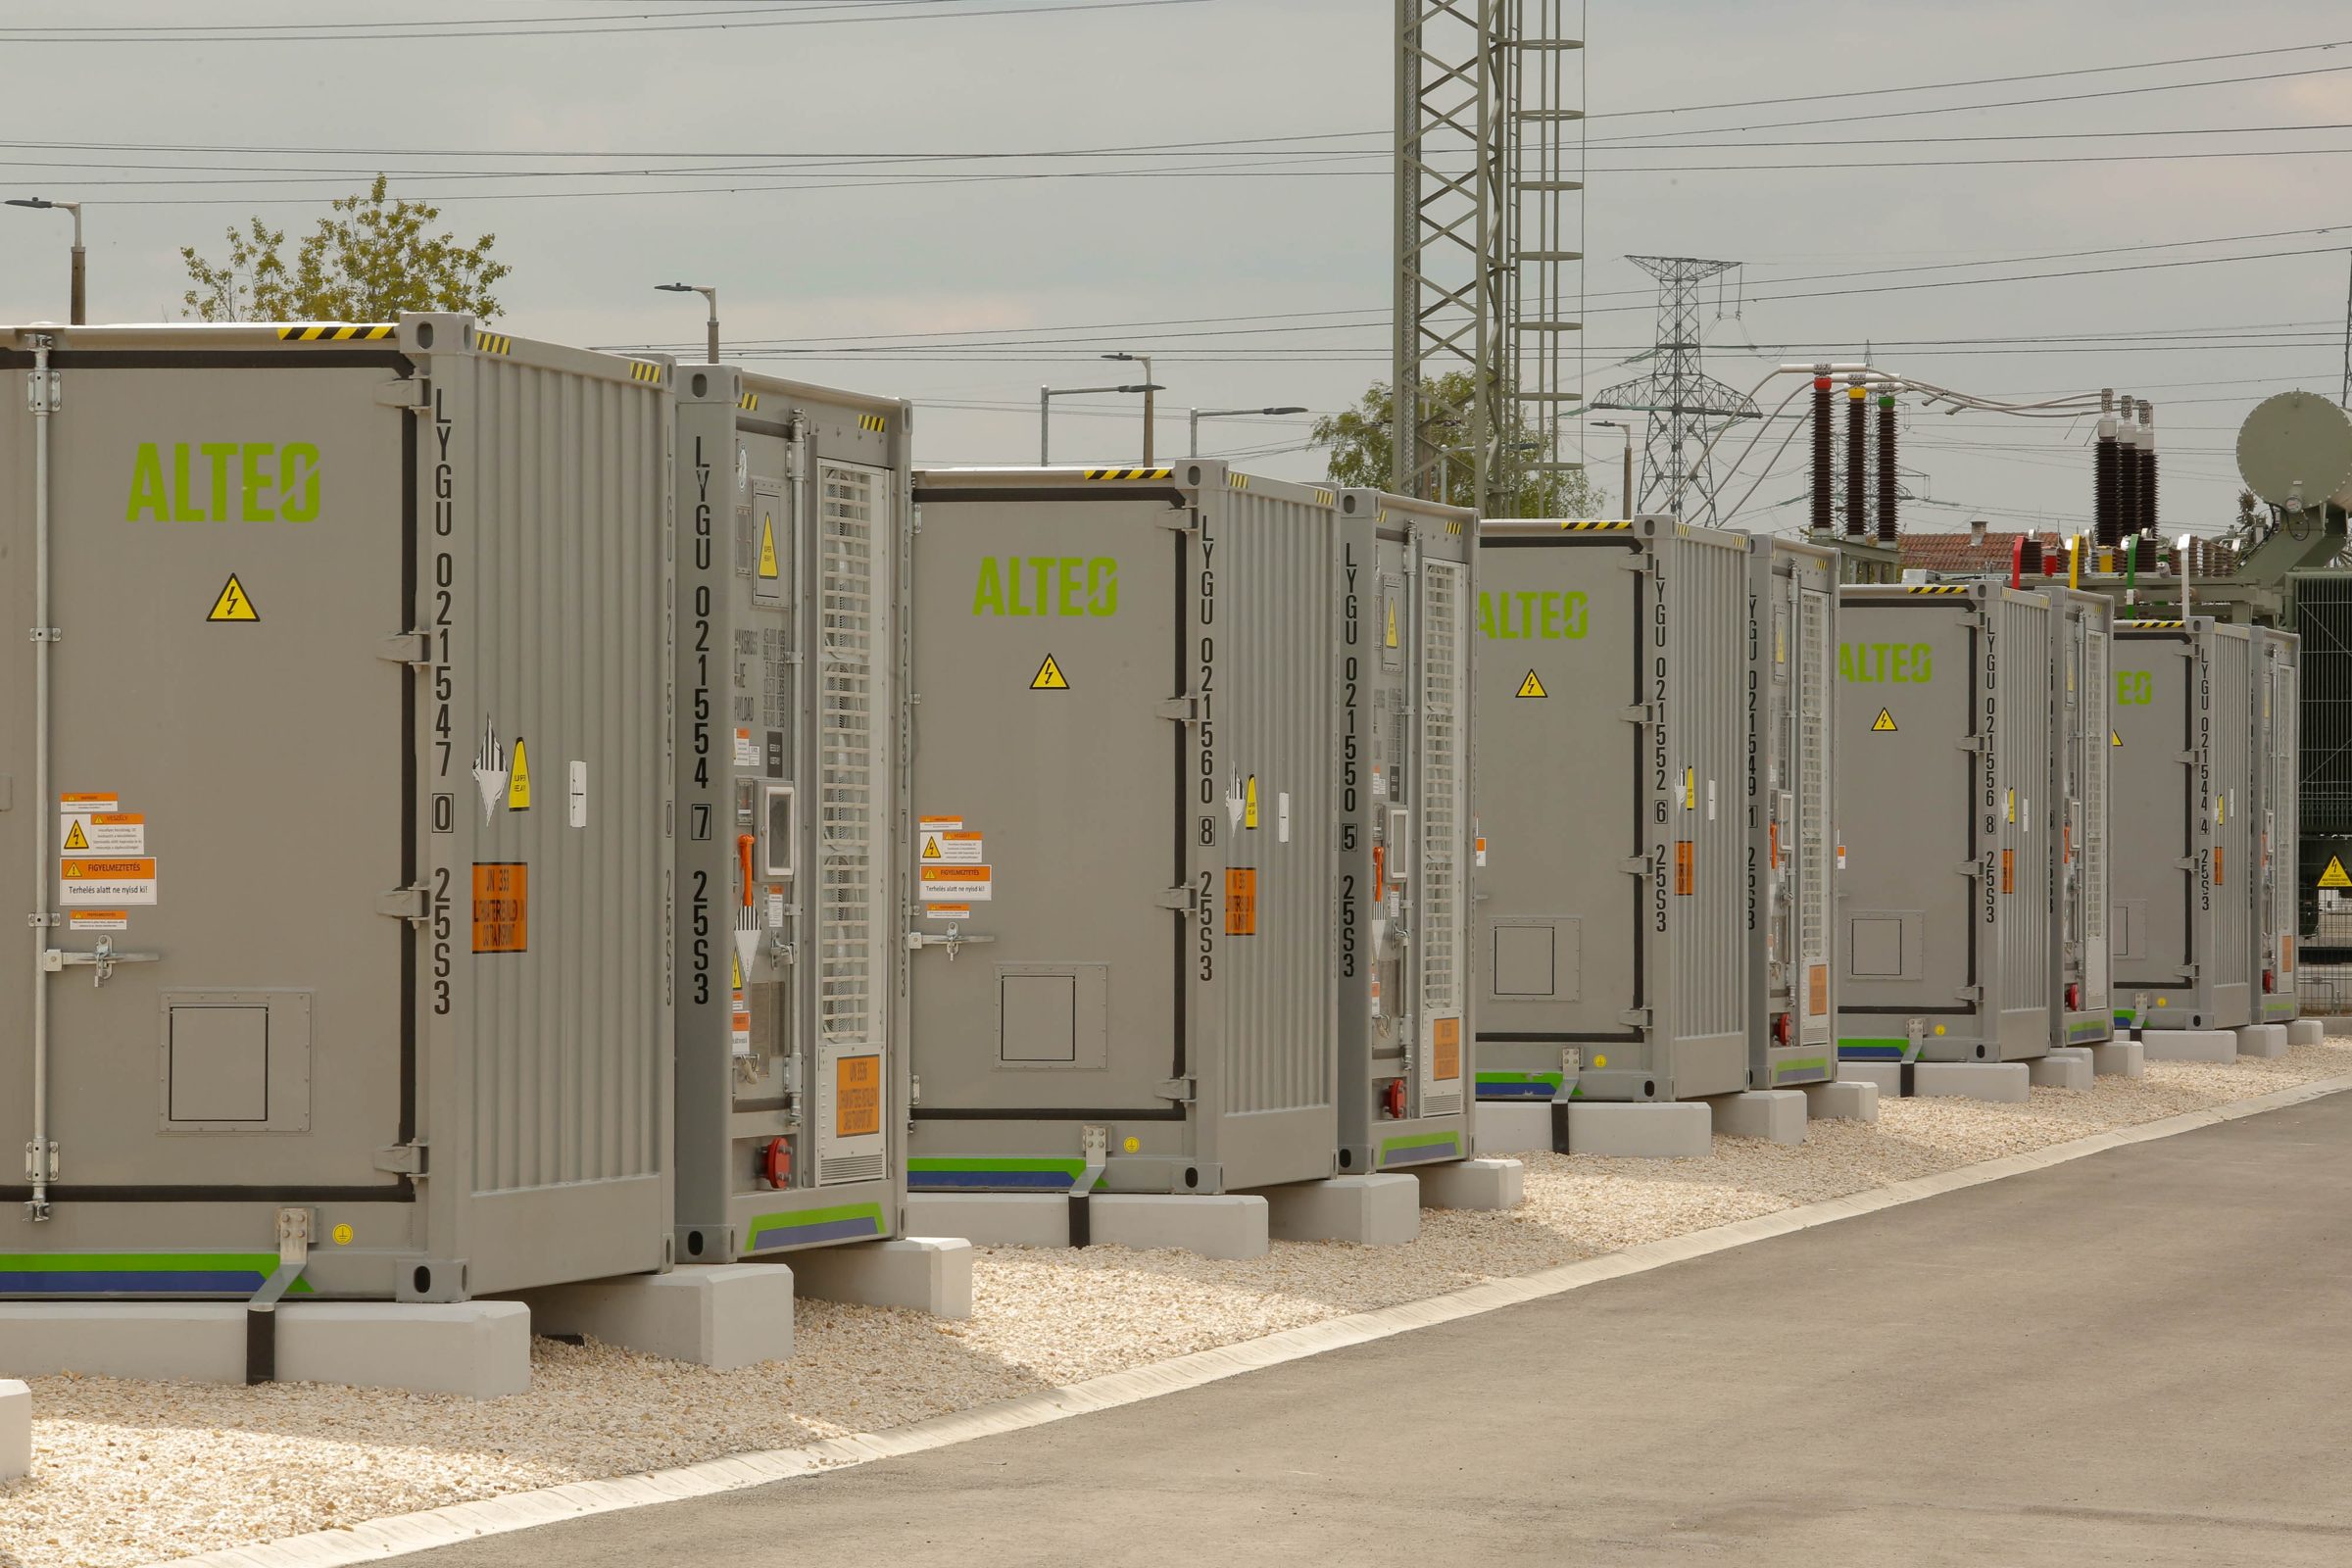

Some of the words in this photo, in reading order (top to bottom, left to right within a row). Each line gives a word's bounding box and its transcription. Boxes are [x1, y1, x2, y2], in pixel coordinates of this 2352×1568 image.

[125, 442, 320, 522] ALTEO
[435, 389, 453, 537] LYGU
[695, 436, 710, 570] LYGU
[972, 557, 1118, 616] ALTEO
[1201, 514, 1215, 625] LYGU
[1346, 542, 1358, 646] LYGU
[1655, 560, 1666, 648] LYGU
[434, 552, 453, 777] 021547
[693, 585, 710, 790] 021554
[1985, 616, 1996, 690] LYGU
[2200, 647, 2209, 711] LYGU
[1200, 636, 1214, 805] 021560
[1344, 656, 1357, 813] 021550
[1655, 658, 1667, 791] 021552
[1985, 697, 1995, 808] 021556
[2200, 716, 2209, 812] 021544
[433, 795, 453, 832] 0
[692, 805, 710, 841] 7
[1200, 817, 1215, 847] 8
[1343, 824, 1356, 851] 5
[69, 885, 95, 895] Terhelés
[87, 861, 141, 872] FIGYELMEZTETÉS
[1655, 844, 1667, 933] 25S3
[1985, 851, 1995, 924] 25S3
[2200, 848, 2210, 911] 25S3
[433, 867, 451, 1015] 25S3
[692, 869, 709, 1005] 25S3
[1199, 870, 1214, 982] 25S3
[1342, 874, 1355, 978] 25S3
